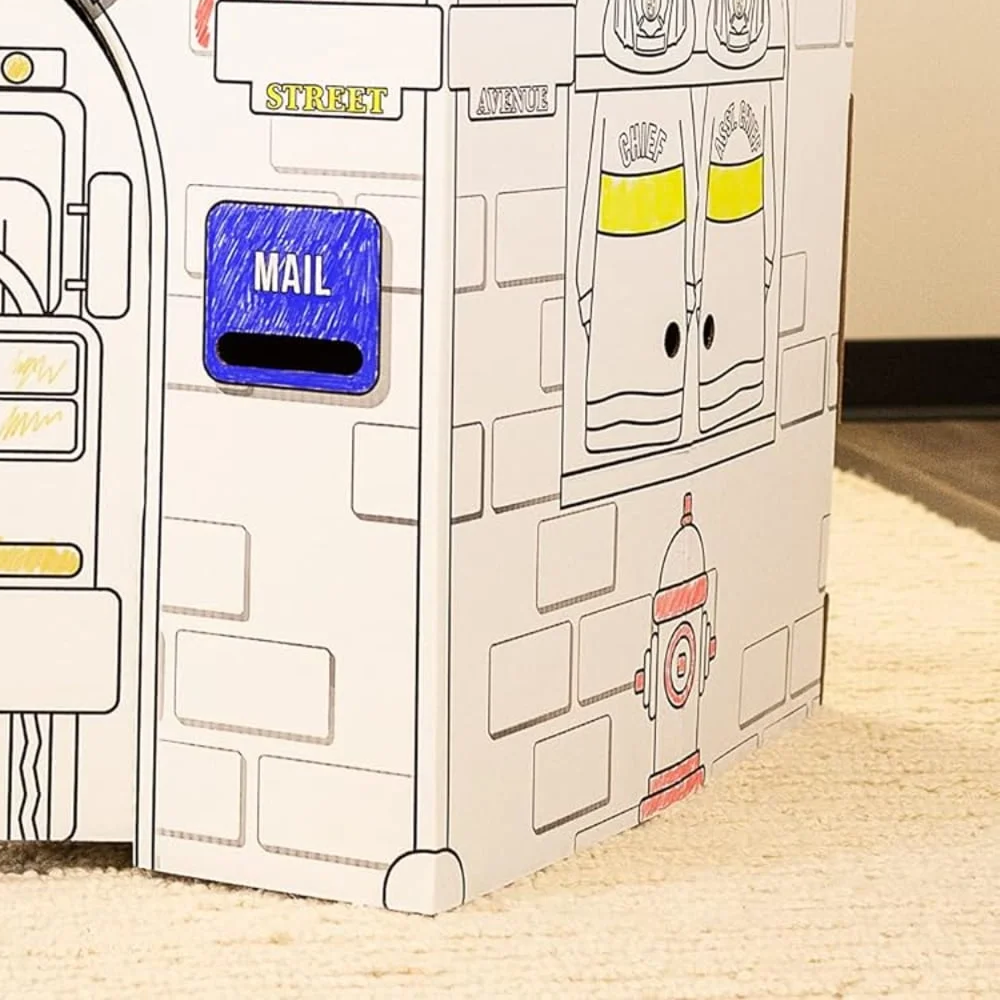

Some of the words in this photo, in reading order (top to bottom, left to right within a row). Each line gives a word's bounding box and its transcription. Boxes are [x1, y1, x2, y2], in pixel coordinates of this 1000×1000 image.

[265, 82, 389, 115] STREET
[476, 84, 549, 116] AVENUE
[618, 121, 667, 168] CHIEF
[254, 250, 332, 297] MAIL
